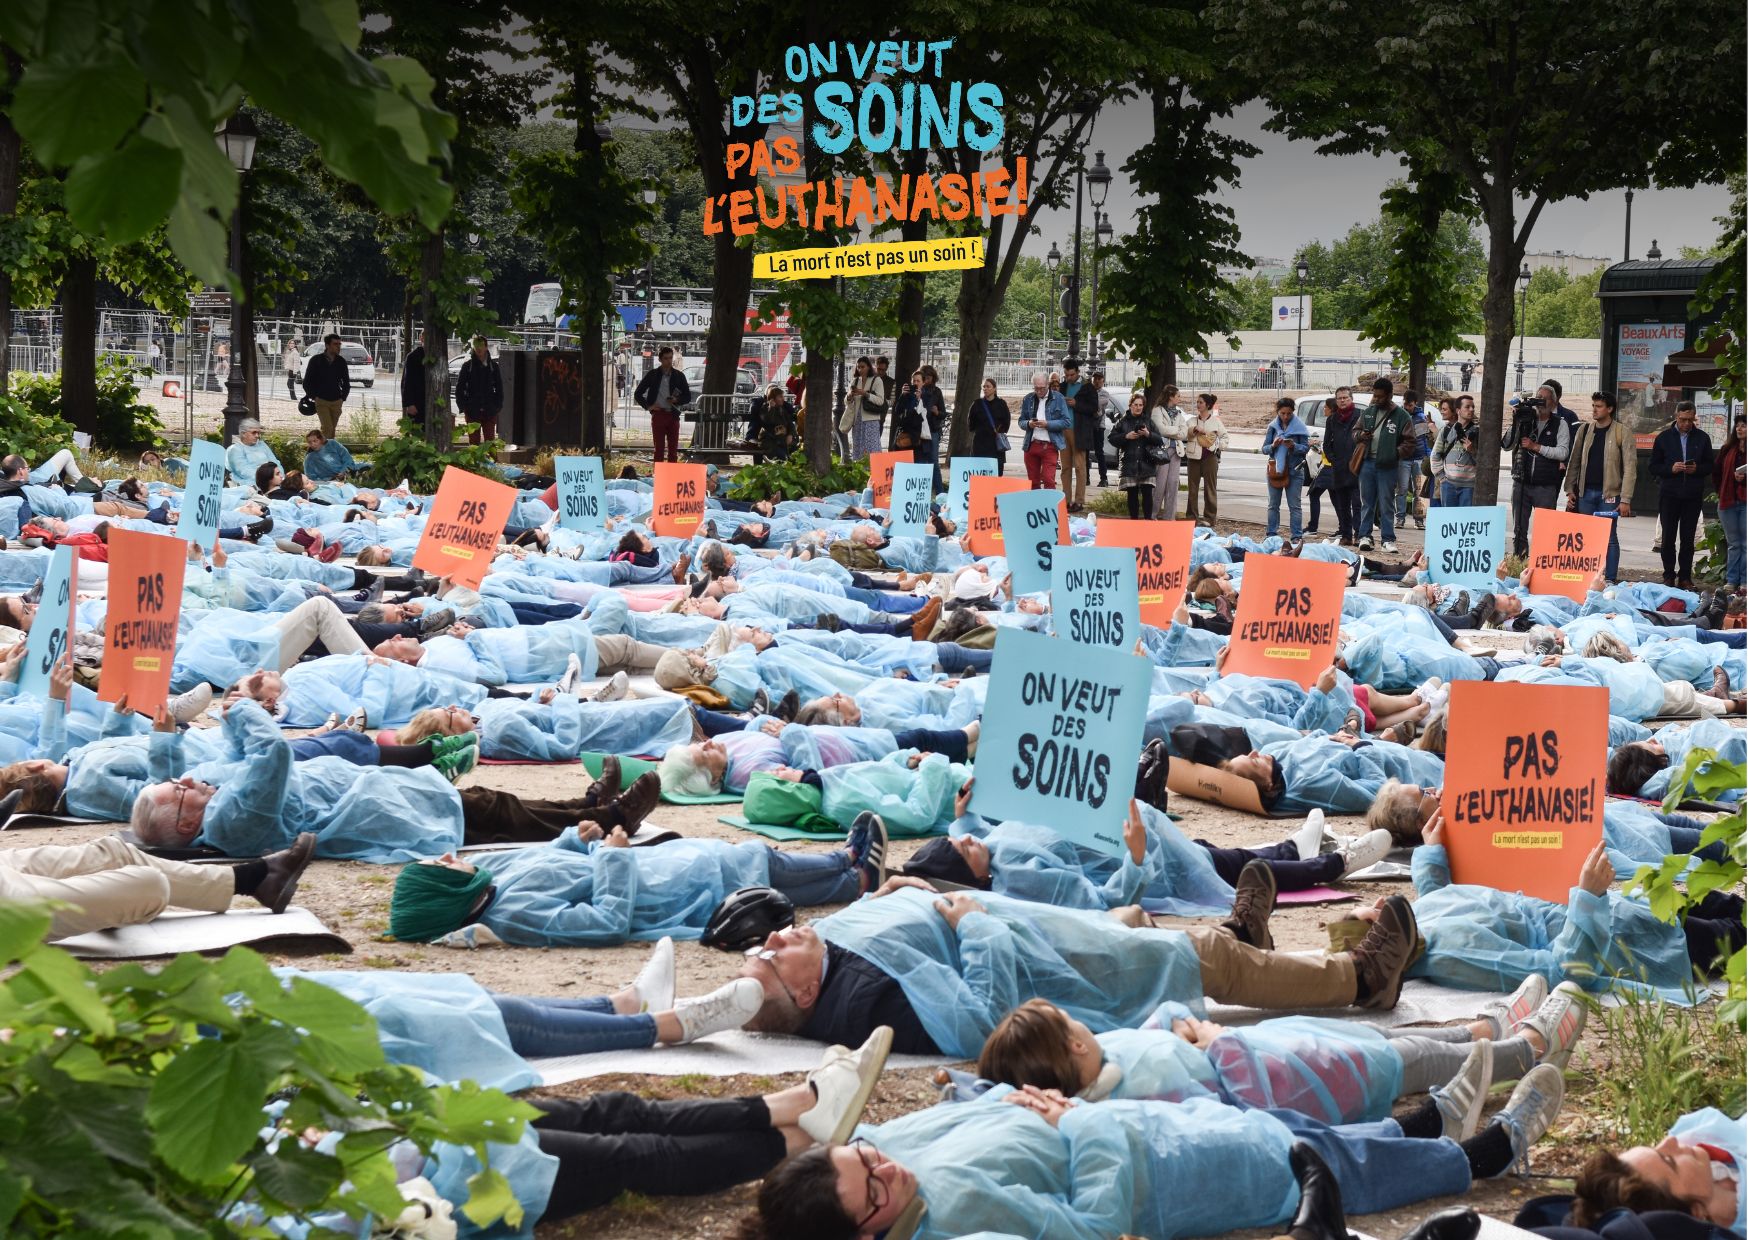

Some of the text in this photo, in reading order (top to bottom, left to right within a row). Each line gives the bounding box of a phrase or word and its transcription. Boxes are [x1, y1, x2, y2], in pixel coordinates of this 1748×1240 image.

[1621, 348, 1650, 356] VOYAGE
[199, 462, 212, 480] ON
[562, 470, 593, 485] ON VEUT
[574, 484, 586, 494] DES
[676, 480, 696, 499] PAS
[905, 478, 917, 492] ON
[457, 500, 487, 525] PAS
[566, 495, 598, 517] SOINS
[1026, 507, 1051, 529] ON
[1441, 520, 1491, 538] ON VEUT
[429, 523, 498, 551] L'EUTHANASIE!
[1458, 538, 1476, 548] DES
[1557, 532, 1584, 553] PAS
[1442, 549, 1492, 574] SOINS
[1535, 554, 1601, 572] L'EUTHANASIE!
[1065, 568, 1121, 592] ON VEUT
[137, 572, 164, 614] PAS
[1084, 593, 1104, 607] DES
[1275, 587, 1312, 617] PAS
[1069, 608, 1124, 647] SOINS
[1240, 618, 1334, 645] L'EUTHANASIE!
[1022, 671, 1122, 722] ON VEUT
[1051, 714, 1086, 740] DES
[1503, 729, 1560, 780] PAS
[1012, 732, 1111, 810] SOINS
[1454, 778, 1595, 825] L'EUTHANASIE!
[1494, 834, 1502, 844] La
[1503, 834, 1516, 844] mort
[1530, 836, 1541, 845] pas
[1541, 836, 1548, 844] un
